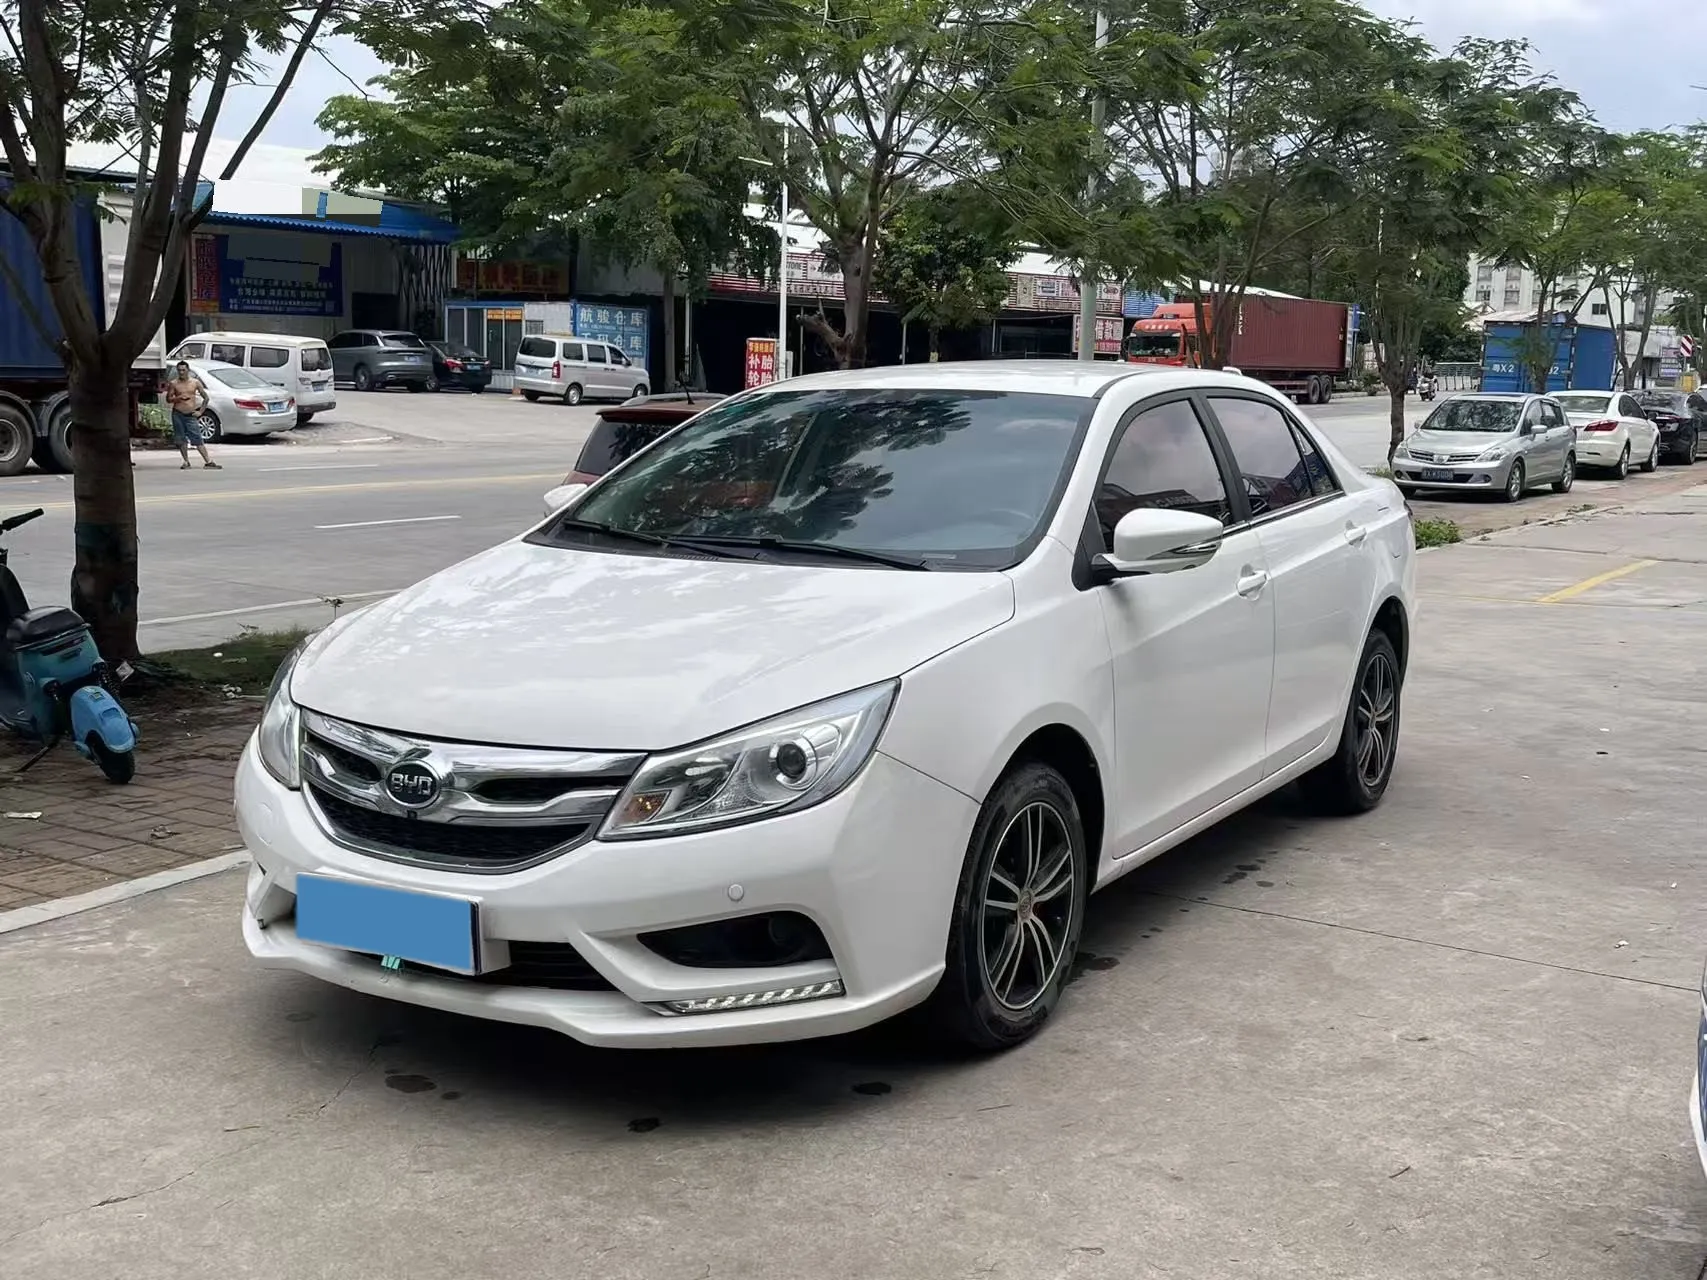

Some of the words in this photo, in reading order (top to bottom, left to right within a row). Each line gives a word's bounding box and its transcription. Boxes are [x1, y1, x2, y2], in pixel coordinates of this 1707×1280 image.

[580, 308, 644, 327] 航骏仓库
[748, 353, 773, 370] 补胎
[748, 370, 773, 386] 轮胎
[391, 772, 433, 796] BYD
